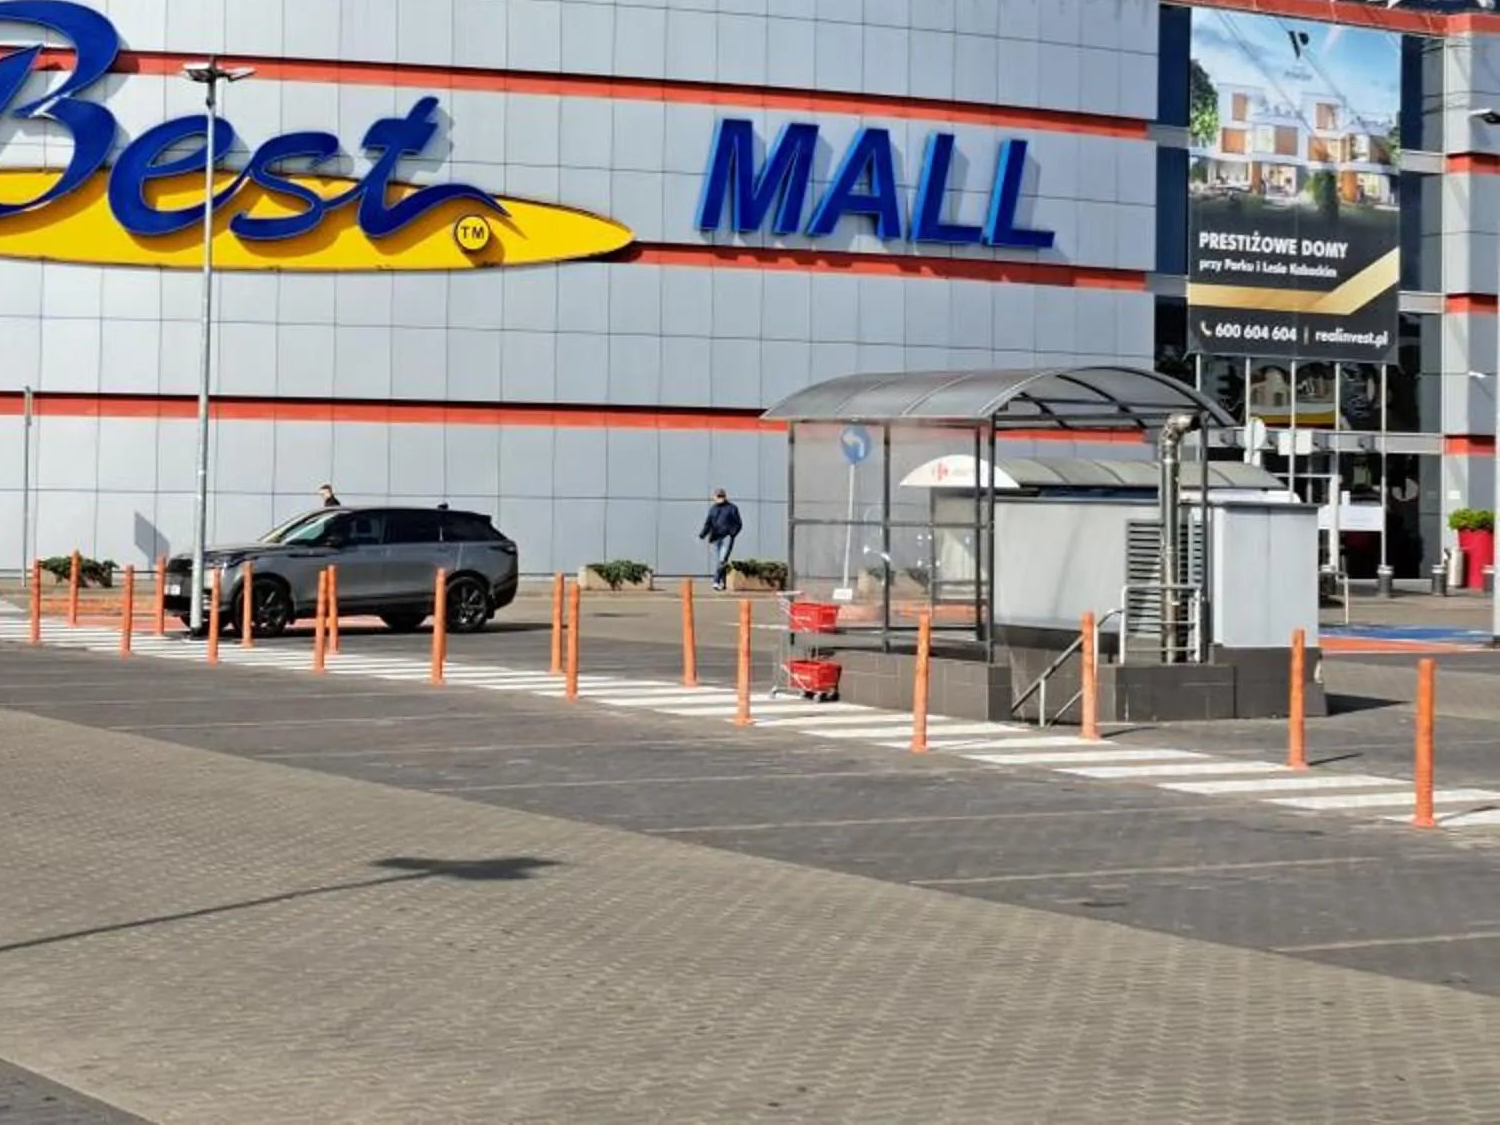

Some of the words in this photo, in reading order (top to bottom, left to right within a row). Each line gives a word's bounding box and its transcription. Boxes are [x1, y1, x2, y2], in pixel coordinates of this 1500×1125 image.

[695, 118, 1055, 248] MALL
[459, 225, 485, 240] TM
[1198, 230, 1298, 255] PRESTIŻOWE
[1301, 239, 1349, 259] DOMY
[1215, 322, 1241, 338] 600
[1244, 324, 1269, 340] 604
[1271, 325, 1297, 341] 604
[1314, 328, 1389, 348] realinvest.pl
